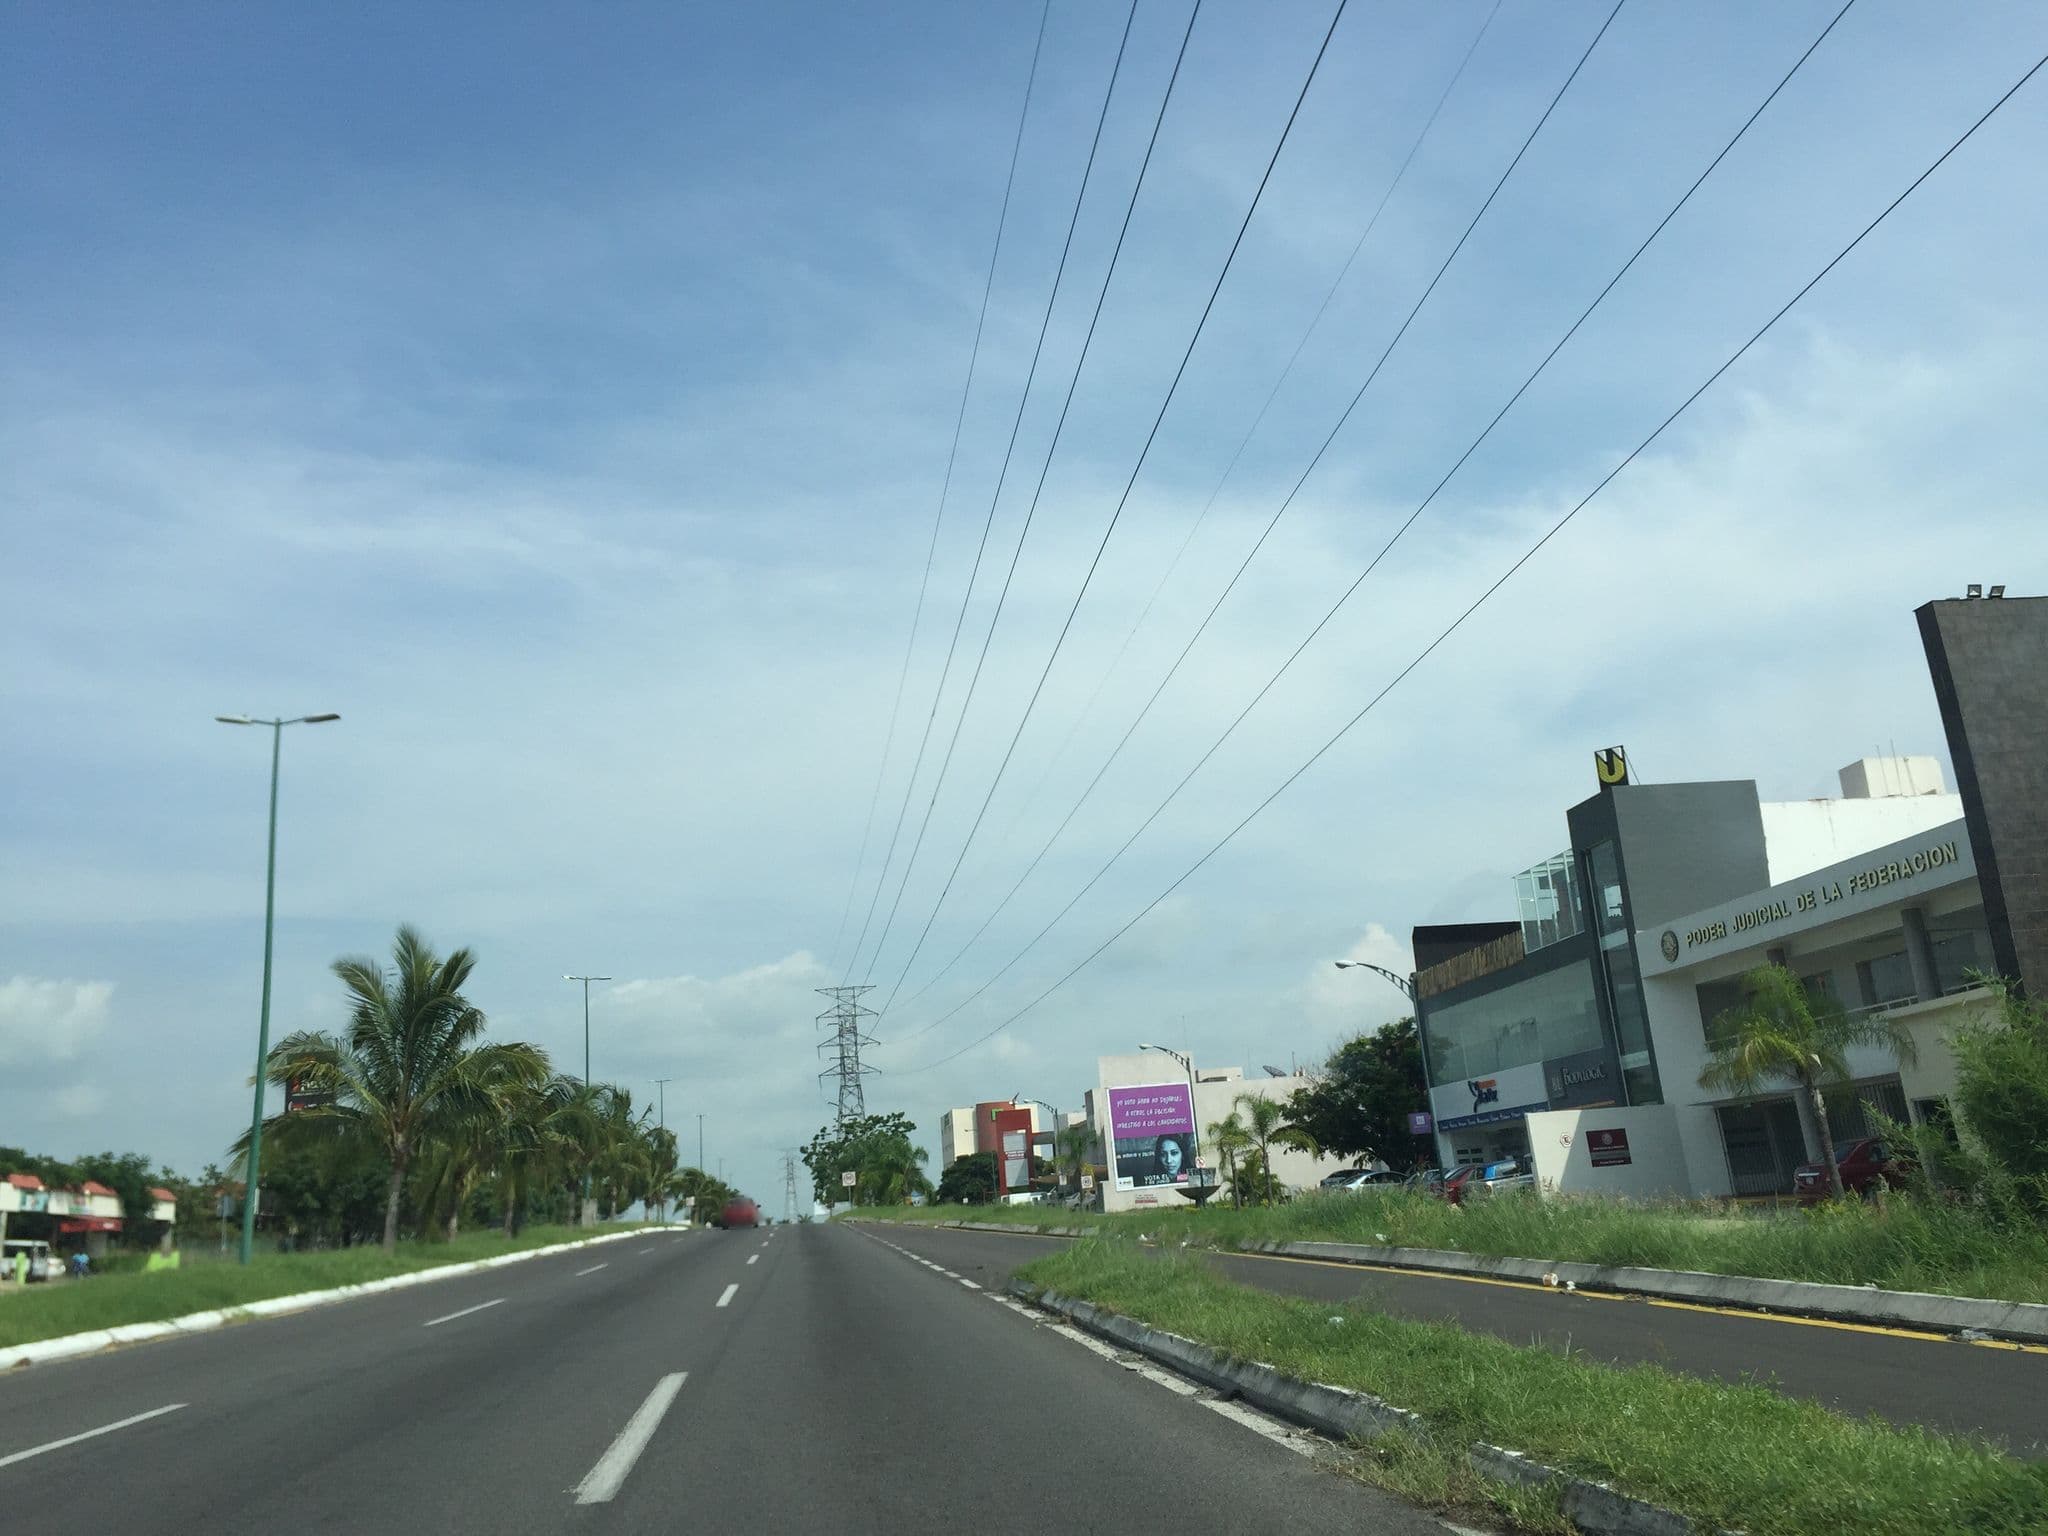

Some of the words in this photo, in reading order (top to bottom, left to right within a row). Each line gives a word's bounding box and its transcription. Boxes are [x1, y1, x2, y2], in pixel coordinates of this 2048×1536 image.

[1686, 921, 1727, 948] PODER
[1732, 899, 1792, 933] JUDICIAL
[1795, 889, 1817, 912] DE
[1821, 882, 1844, 903] LA
[1848, 841, 1959, 895] FEDERACION
